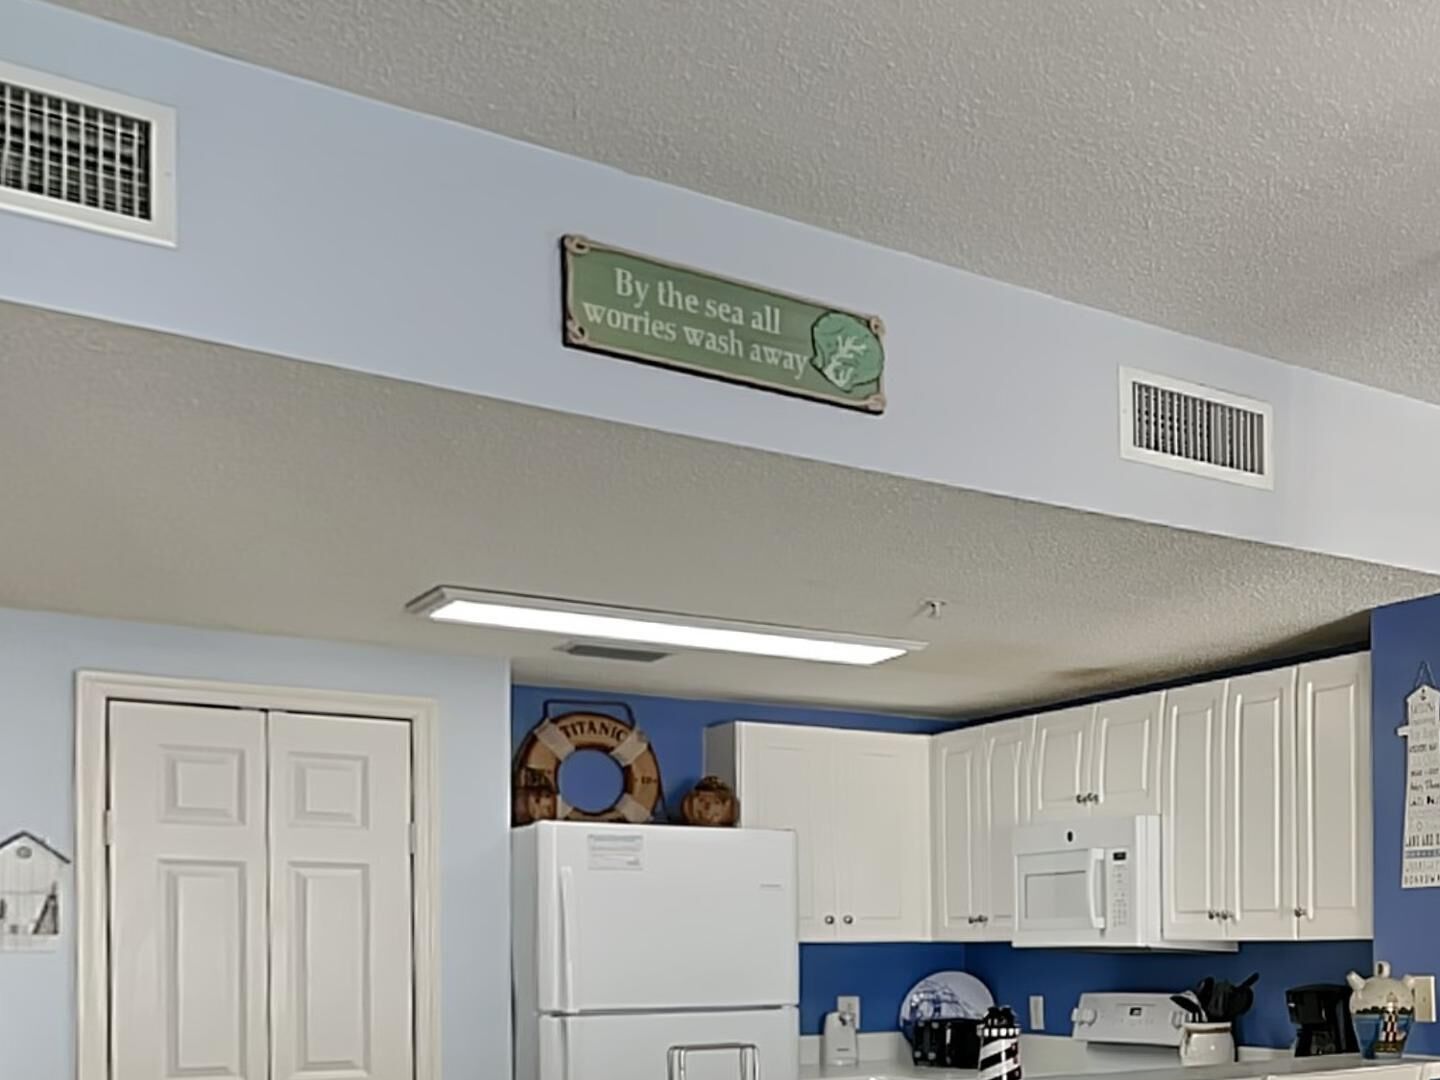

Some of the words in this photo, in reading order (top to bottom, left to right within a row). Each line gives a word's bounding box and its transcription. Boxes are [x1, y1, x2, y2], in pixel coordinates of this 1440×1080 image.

[614, 267, 649, 307] By
[657, 280, 699, 314] the
[704, 299, 744, 326] sea
[751, 306, 781, 334] all
[581, 301, 677, 341] worries
[683, 324, 744, 358] wash
[750, 343, 811, 381] away
[559, 720, 629, 743] TITANIC
